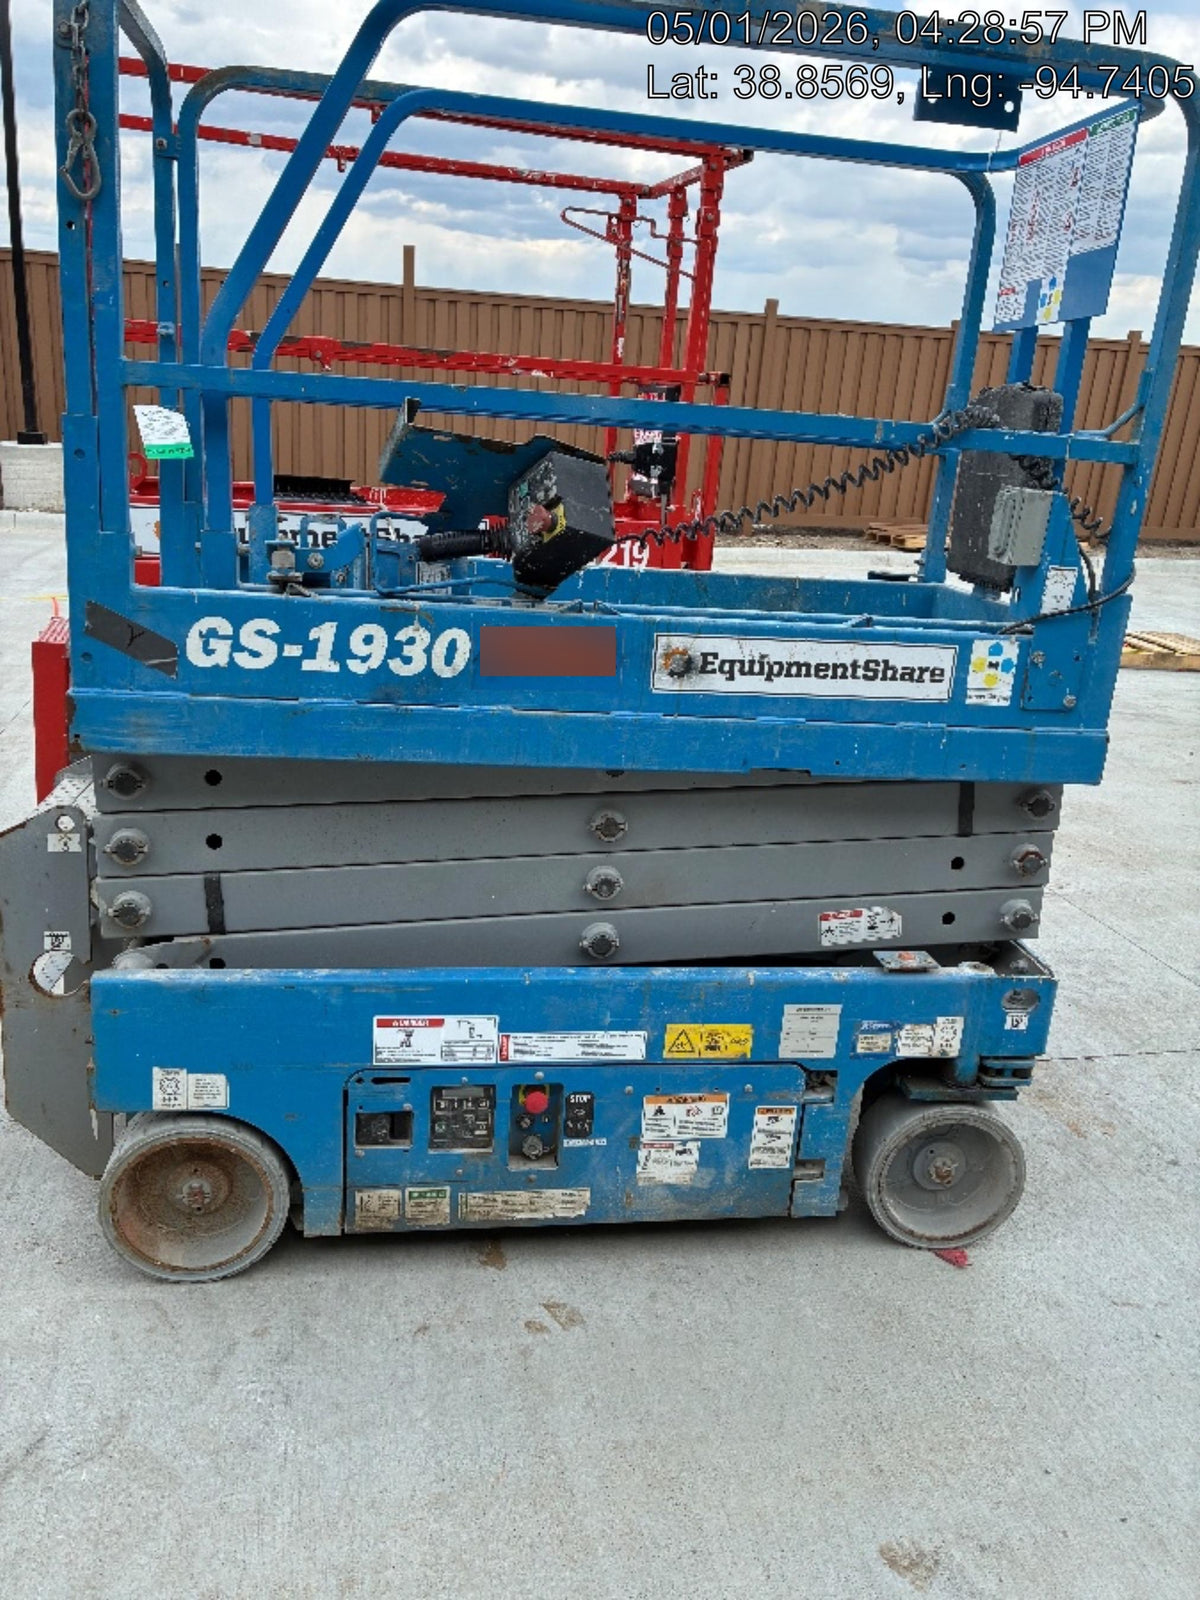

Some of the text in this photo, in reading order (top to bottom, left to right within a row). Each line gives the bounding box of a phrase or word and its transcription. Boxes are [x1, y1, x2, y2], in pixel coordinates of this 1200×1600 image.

[186, 616, 472, 678] GS-1930
[700, 652, 945, 683] EquipmentShare
[569, 1094, 591, 1103] STOP
